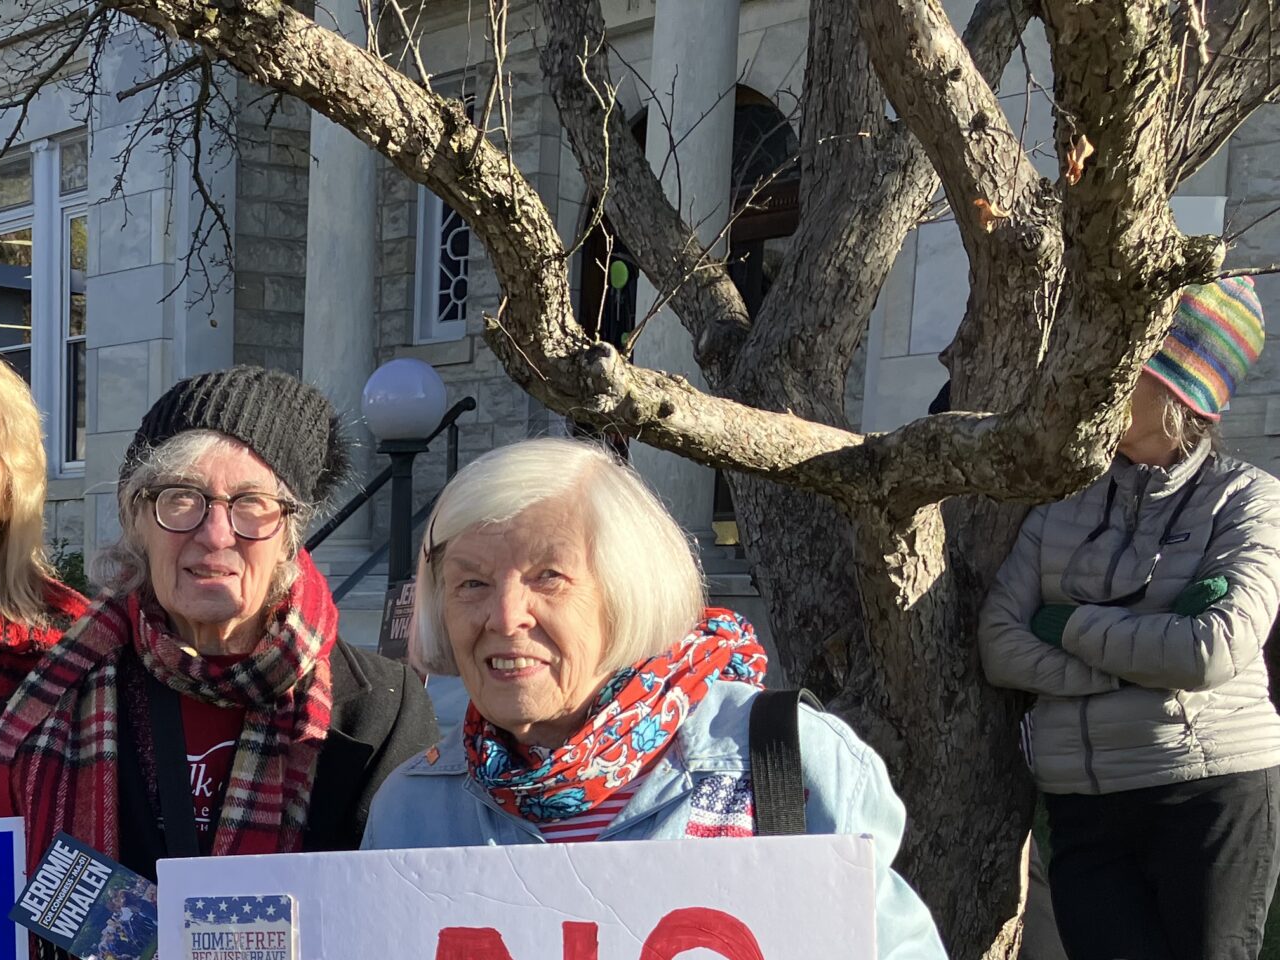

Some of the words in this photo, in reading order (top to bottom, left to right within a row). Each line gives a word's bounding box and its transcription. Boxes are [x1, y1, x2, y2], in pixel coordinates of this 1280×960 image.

[20, 840, 79, 922] JEROMIE
[42, 911, 55, 925] FOR
[51, 878, 74, 912] CONGRESS
[51, 859, 112, 939] WHALEN
[192, 932, 234, 950] HOME
[245, 931, 286, 950] FREE
